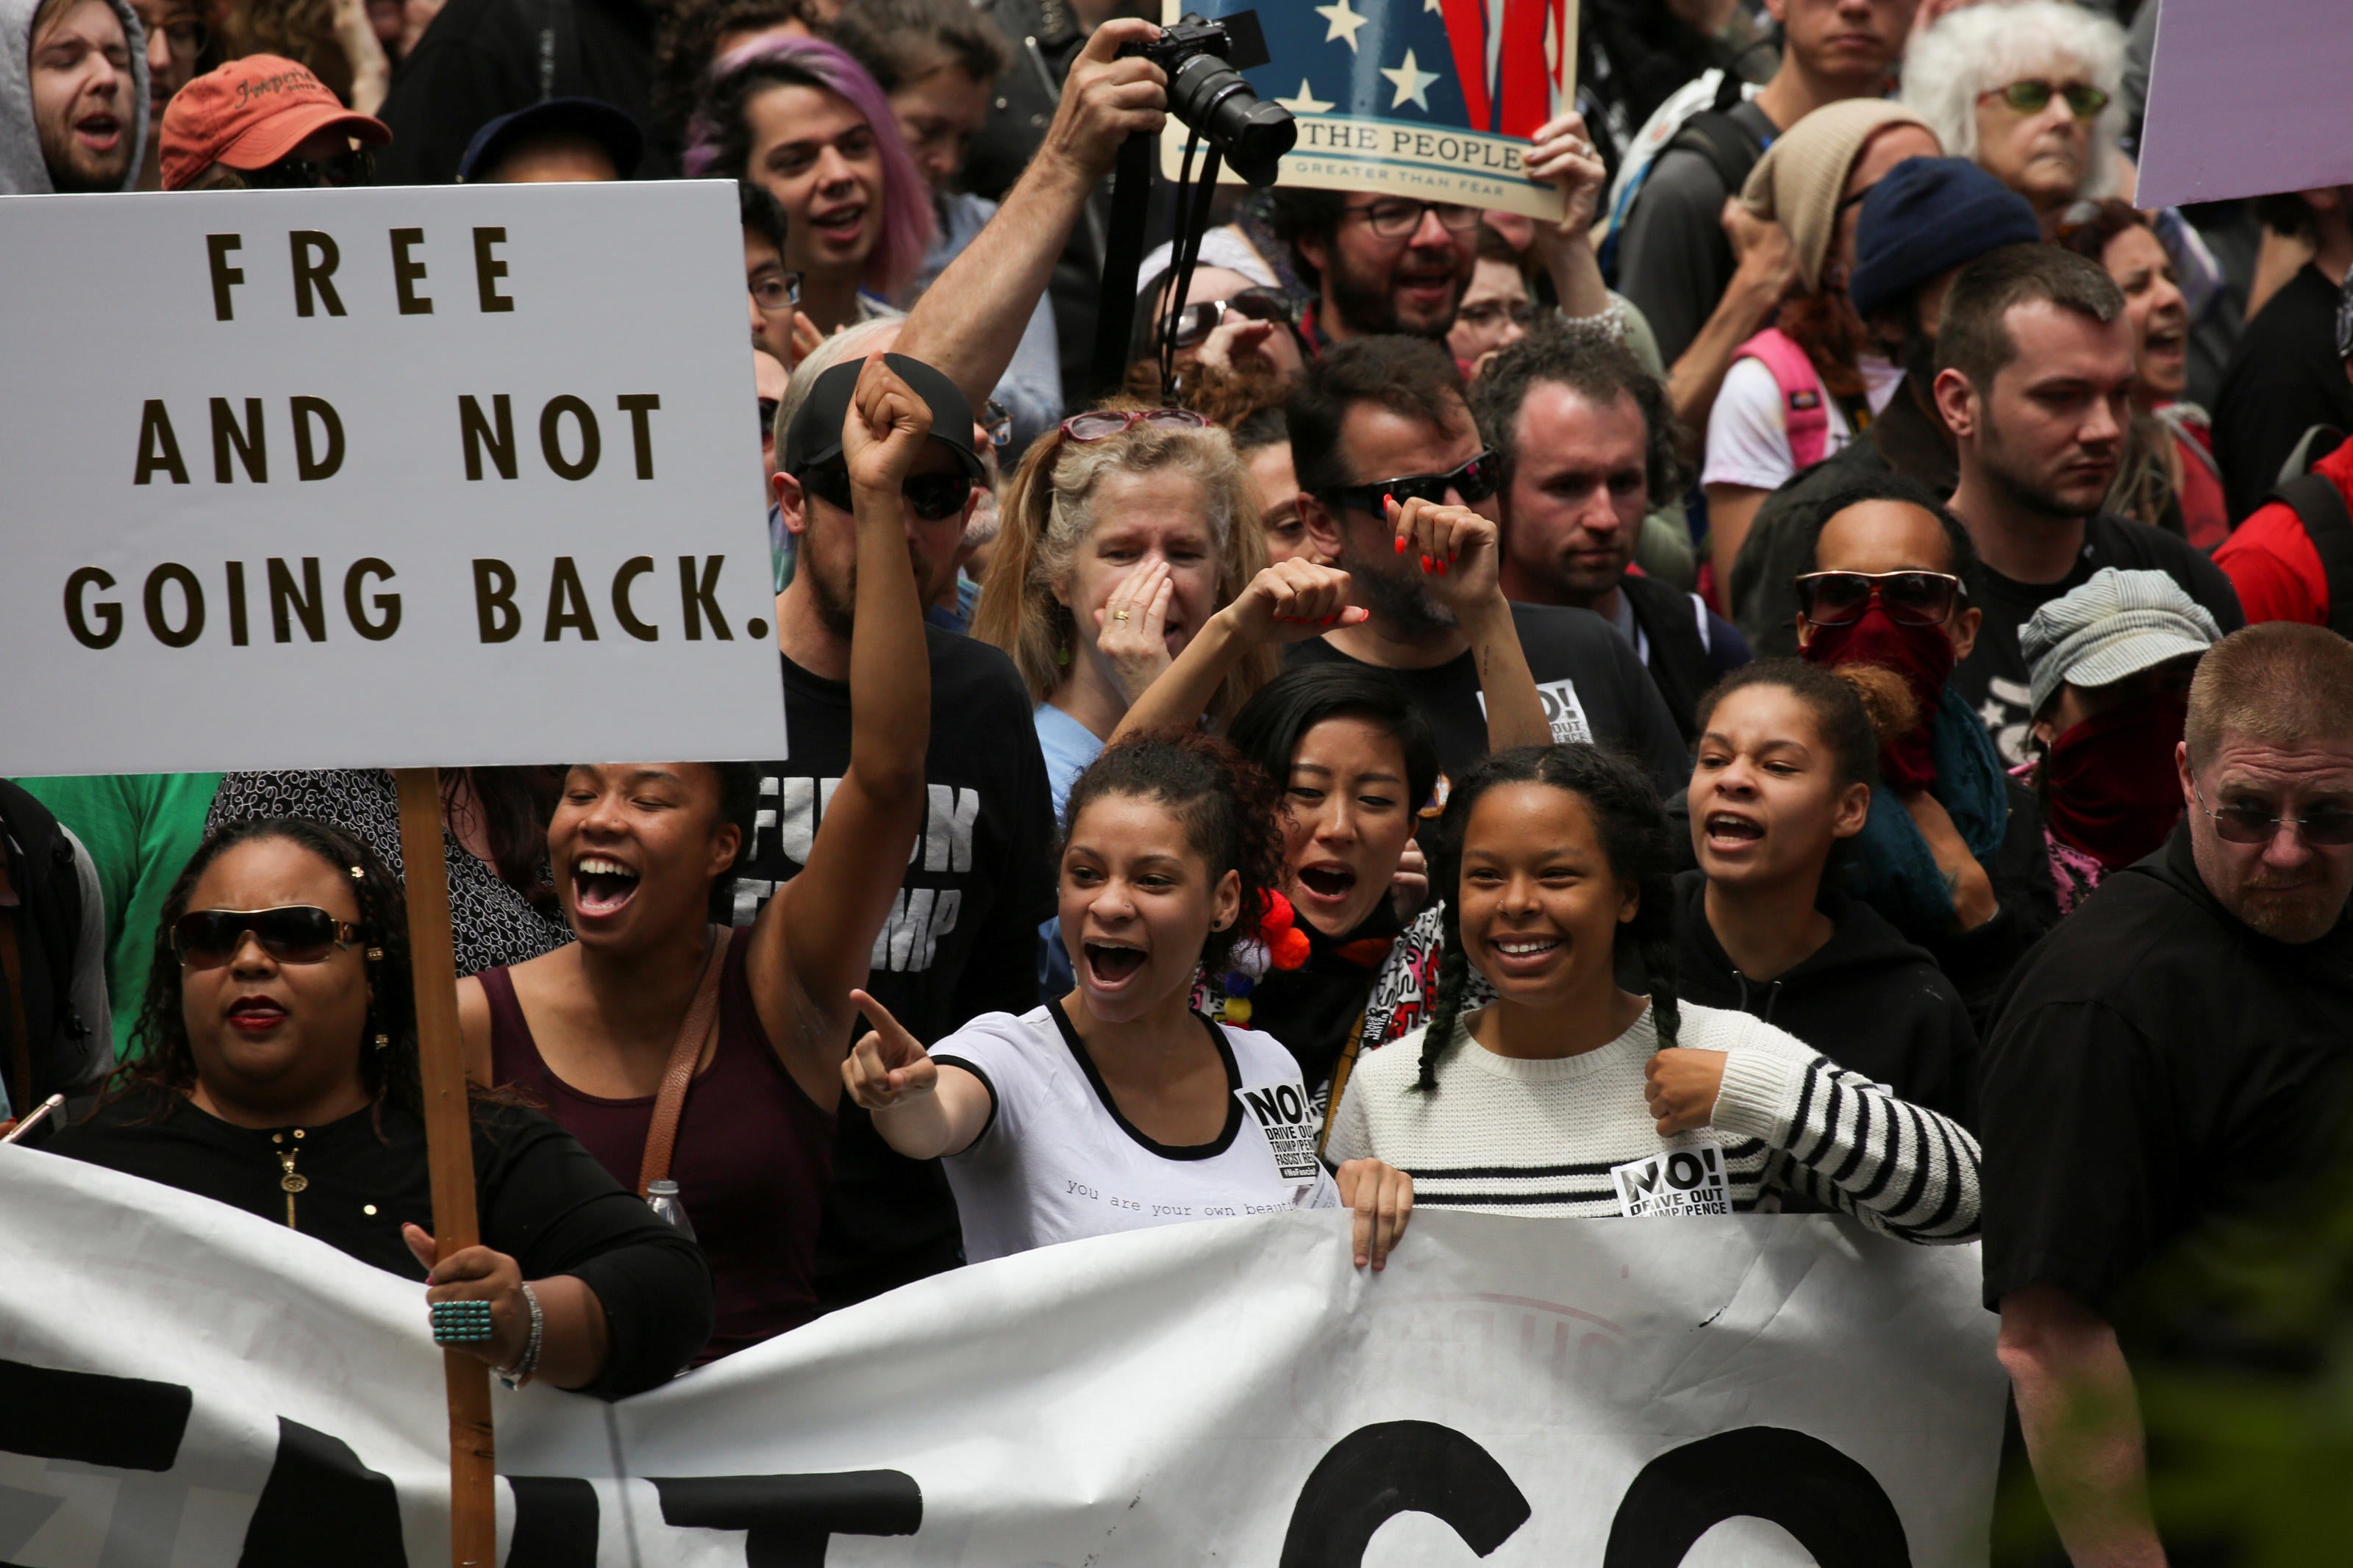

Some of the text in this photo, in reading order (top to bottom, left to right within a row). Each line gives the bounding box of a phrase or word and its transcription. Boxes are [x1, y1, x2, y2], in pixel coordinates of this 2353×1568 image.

[1302, 123, 1522, 171] THE PEOPLE
[1296, 162, 1388, 179] GREATER
[1399, 171, 1449, 188] THAN
[1459, 181, 1504, 196] FEAR
[206, 226, 514, 321] FREE
[133, 393, 660, 485] AND NOT
[63, 554, 769, 648] GOING BACK.
[1552, 721, 1580, 734] OUT
[747, 776, 979, 873] FUK
[724, 878, 962, 972] TMP
[1243, 1084, 1311, 1126] NO!
[1265, 1126, 1297, 1140] DRIVE
[1275, 1153, 1304, 1166] FASCIST
[1621, 1148, 1721, 1203] NO!
[1066, 1179, 1099, 1200] you
[1110, 1196, 1140, 1211] are
[1152, 1203, 1192, 1217] your
[1204, 1205, 1235, 1216] own
[1630, 1188, 1724, 1216] DRIVE OUT
[1634, 1202, 1728, 1217] UMP/PENCE
